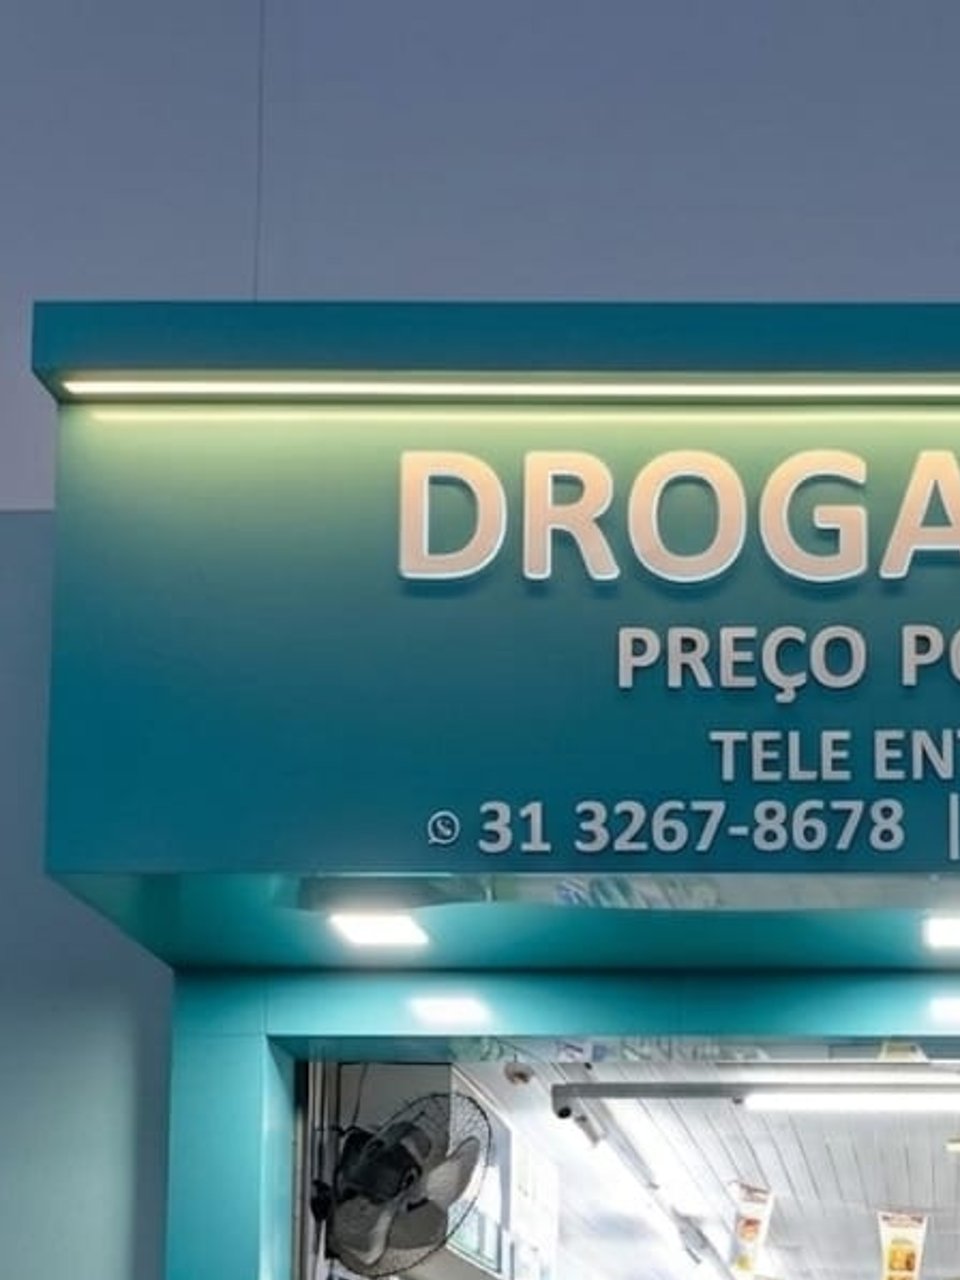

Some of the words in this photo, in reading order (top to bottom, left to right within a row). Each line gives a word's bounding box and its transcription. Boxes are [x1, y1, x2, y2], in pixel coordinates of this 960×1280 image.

[617, 625, 866, 702] PREÇO
[709, 729, 852, 781] TELE
[477, 801, 552, 853] 31
[574, 799, 905, 853] 3267-8678
